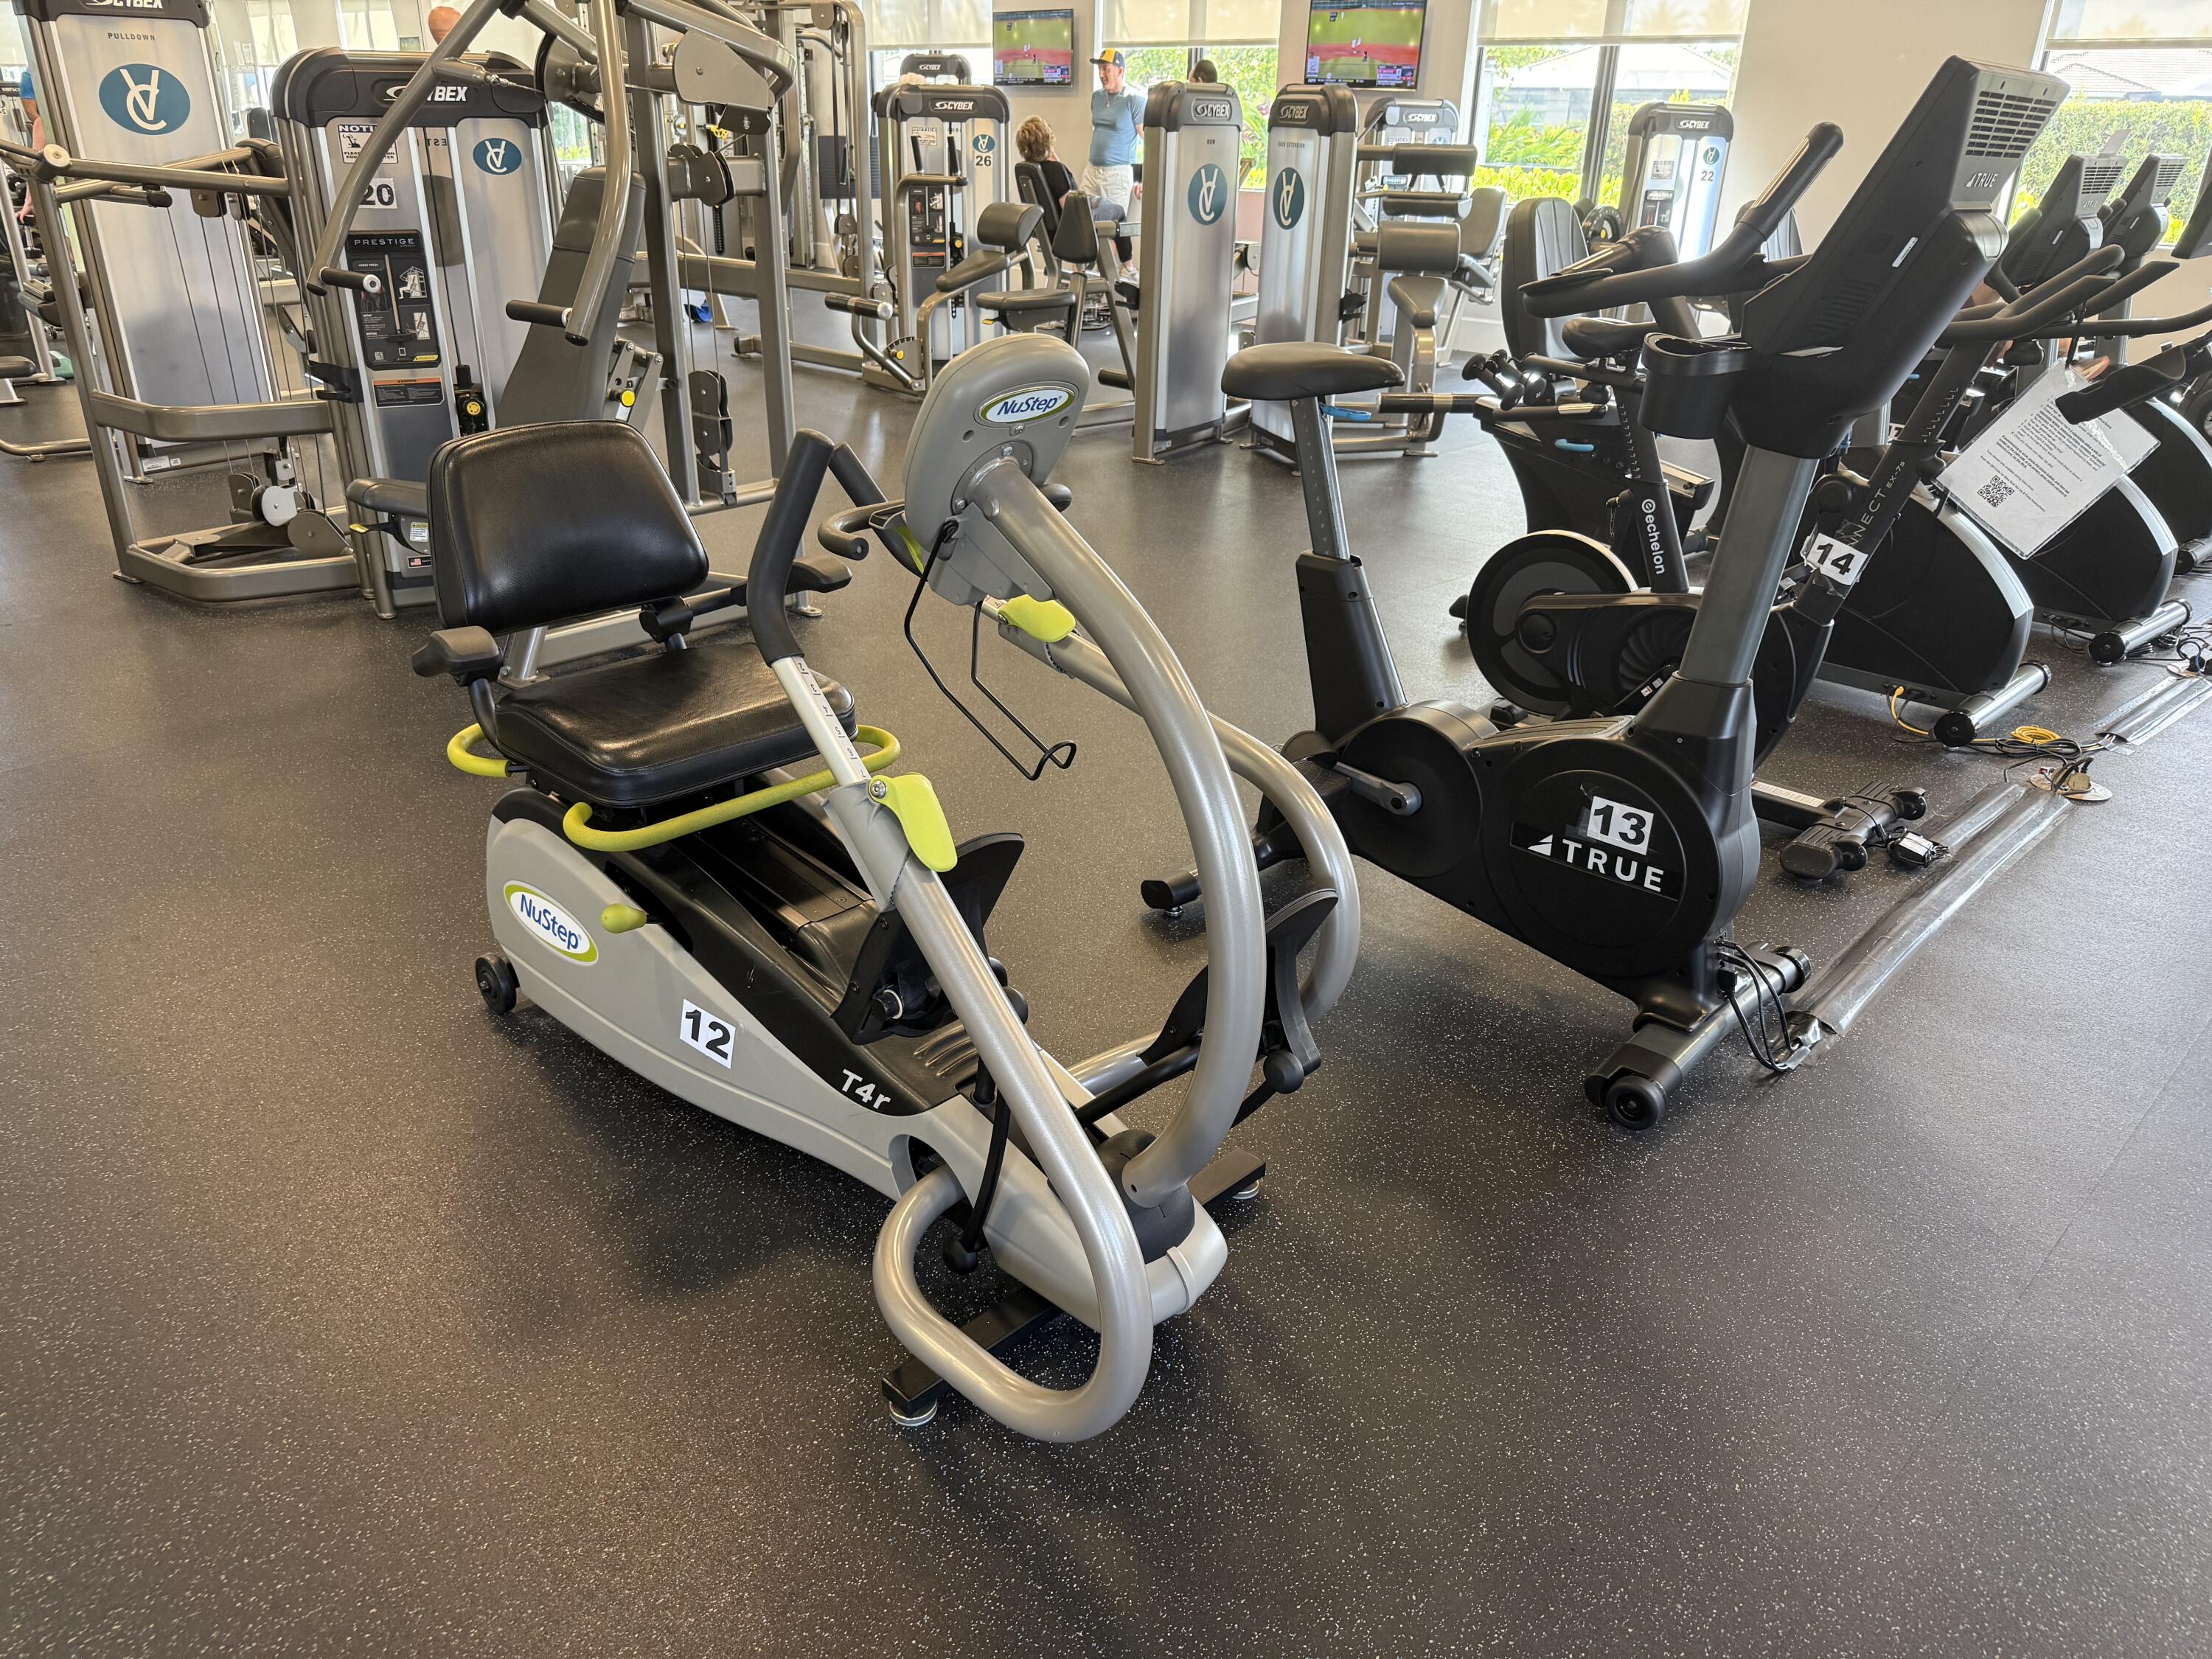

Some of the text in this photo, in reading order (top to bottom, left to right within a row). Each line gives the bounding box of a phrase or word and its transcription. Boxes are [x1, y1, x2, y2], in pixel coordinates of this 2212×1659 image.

[108, 32, 156, 41] PULLDOWN
[427, 86, 467, 102] BEX
[947, 102, 974, 110] CYBEX
[1207, 103, 1230, 117] CYBEX
[1288, 105, 1309, 119] CYBEX
[1688, 120, 1710, 129] CYBEX
[975, 156, 992, 167] 26
[1700, 170, 1714, 182] 22
[1974, 173, 1998, 187] TRUE
[1645, 514, 1666, 574] echelon
[1817, 543, 1855, 576] 14
[1593, 804, 1646, 845] 13
[1562, 839, 1664, 892] TRUE
[685, 1009, 731, 1060] 12
[842, 1069, 891, 1110] T4r
